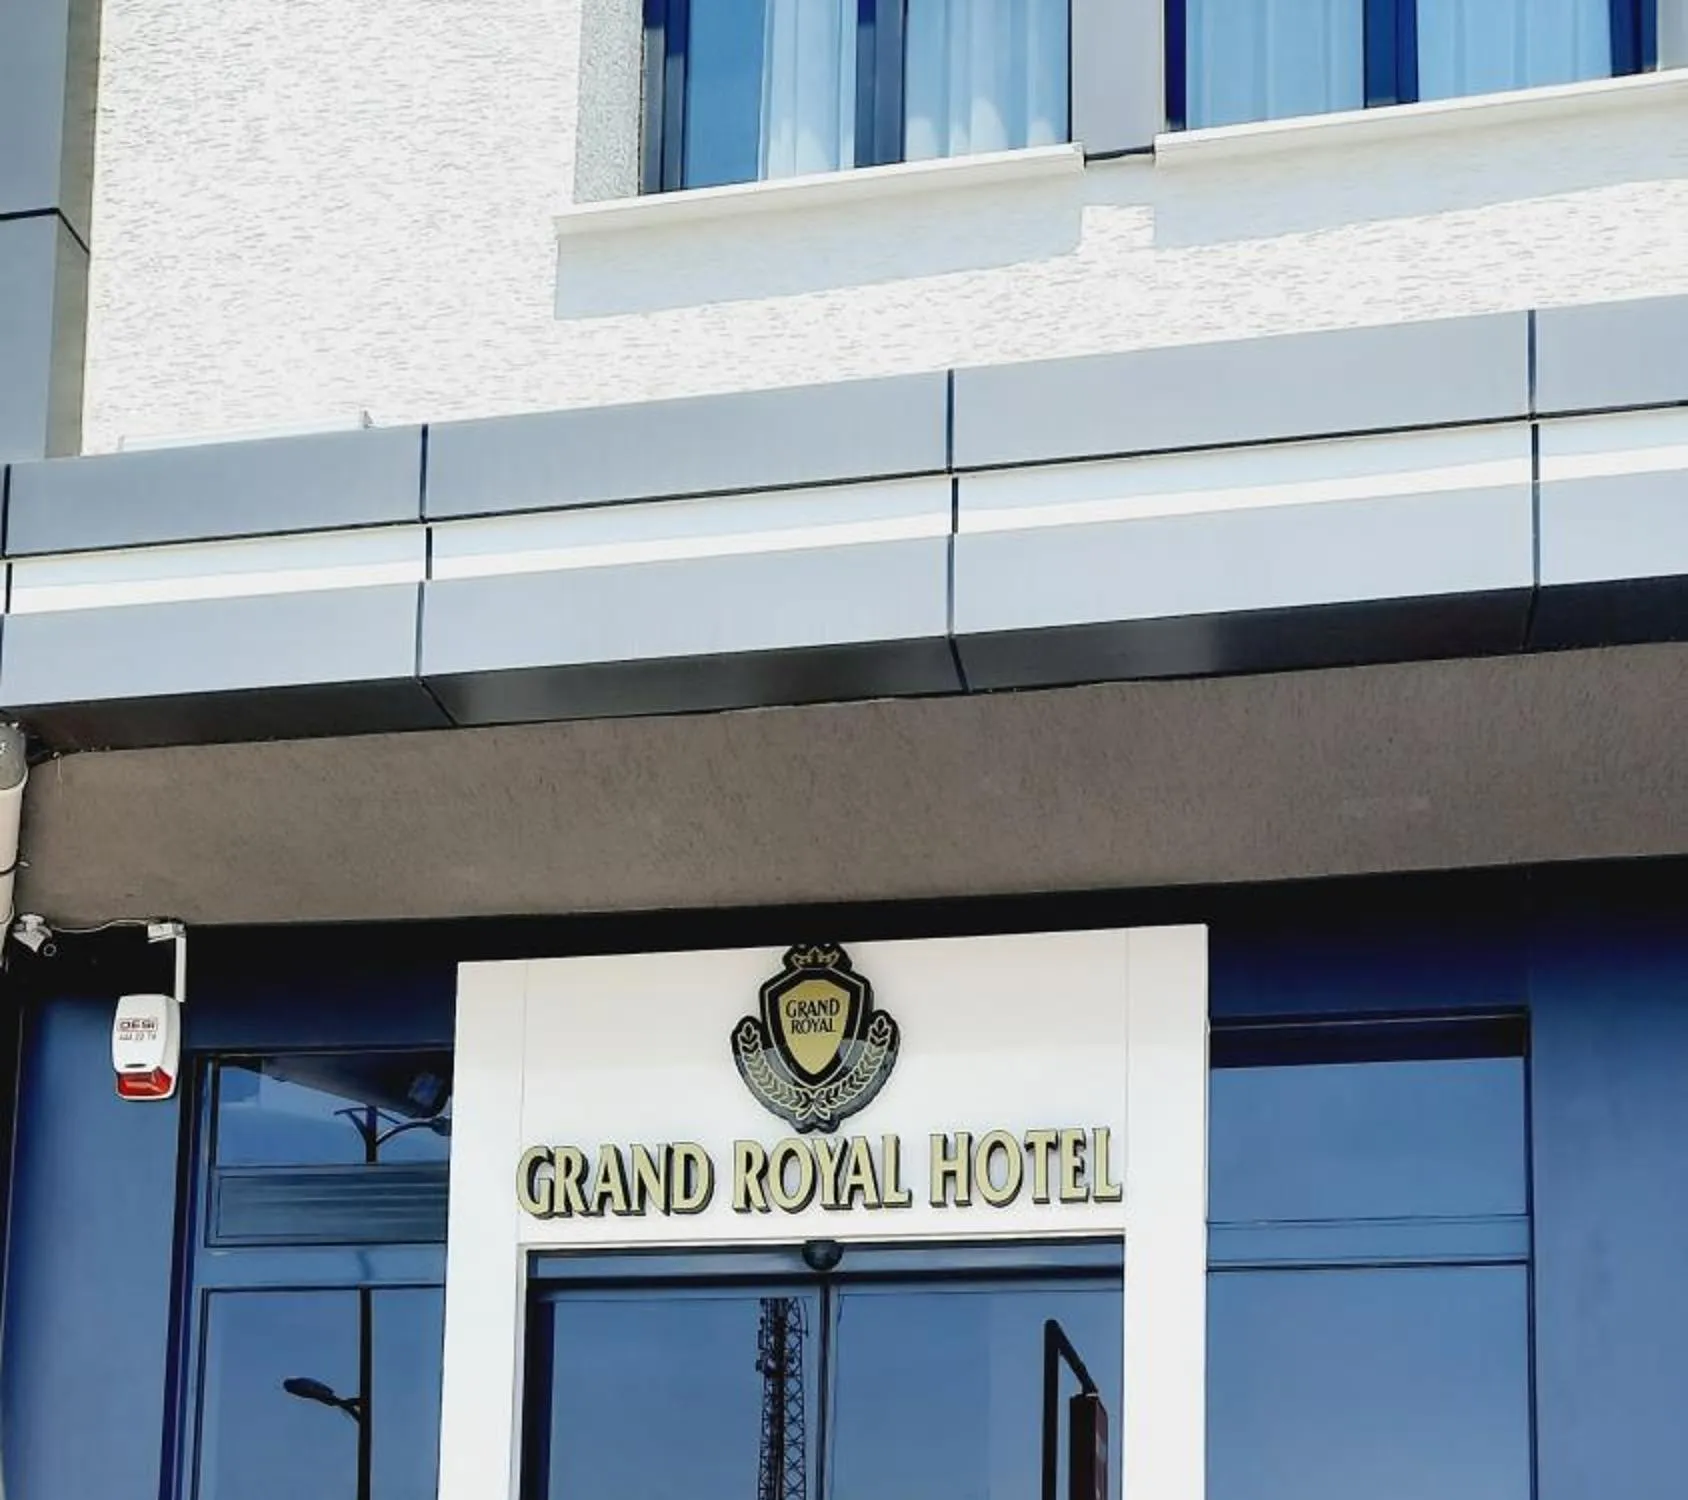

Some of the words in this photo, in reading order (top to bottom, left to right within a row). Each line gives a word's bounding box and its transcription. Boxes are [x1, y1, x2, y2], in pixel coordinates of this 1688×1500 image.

[785, 998, 841, 1018] GRAND
[790, 1016, 837, 1035] ROYAL
[516, 1142, 715, 1219] GRAND
[731, 1133, 912, 1213] ROYAL
[929, 1127, 1123, 1207] HOTEL
